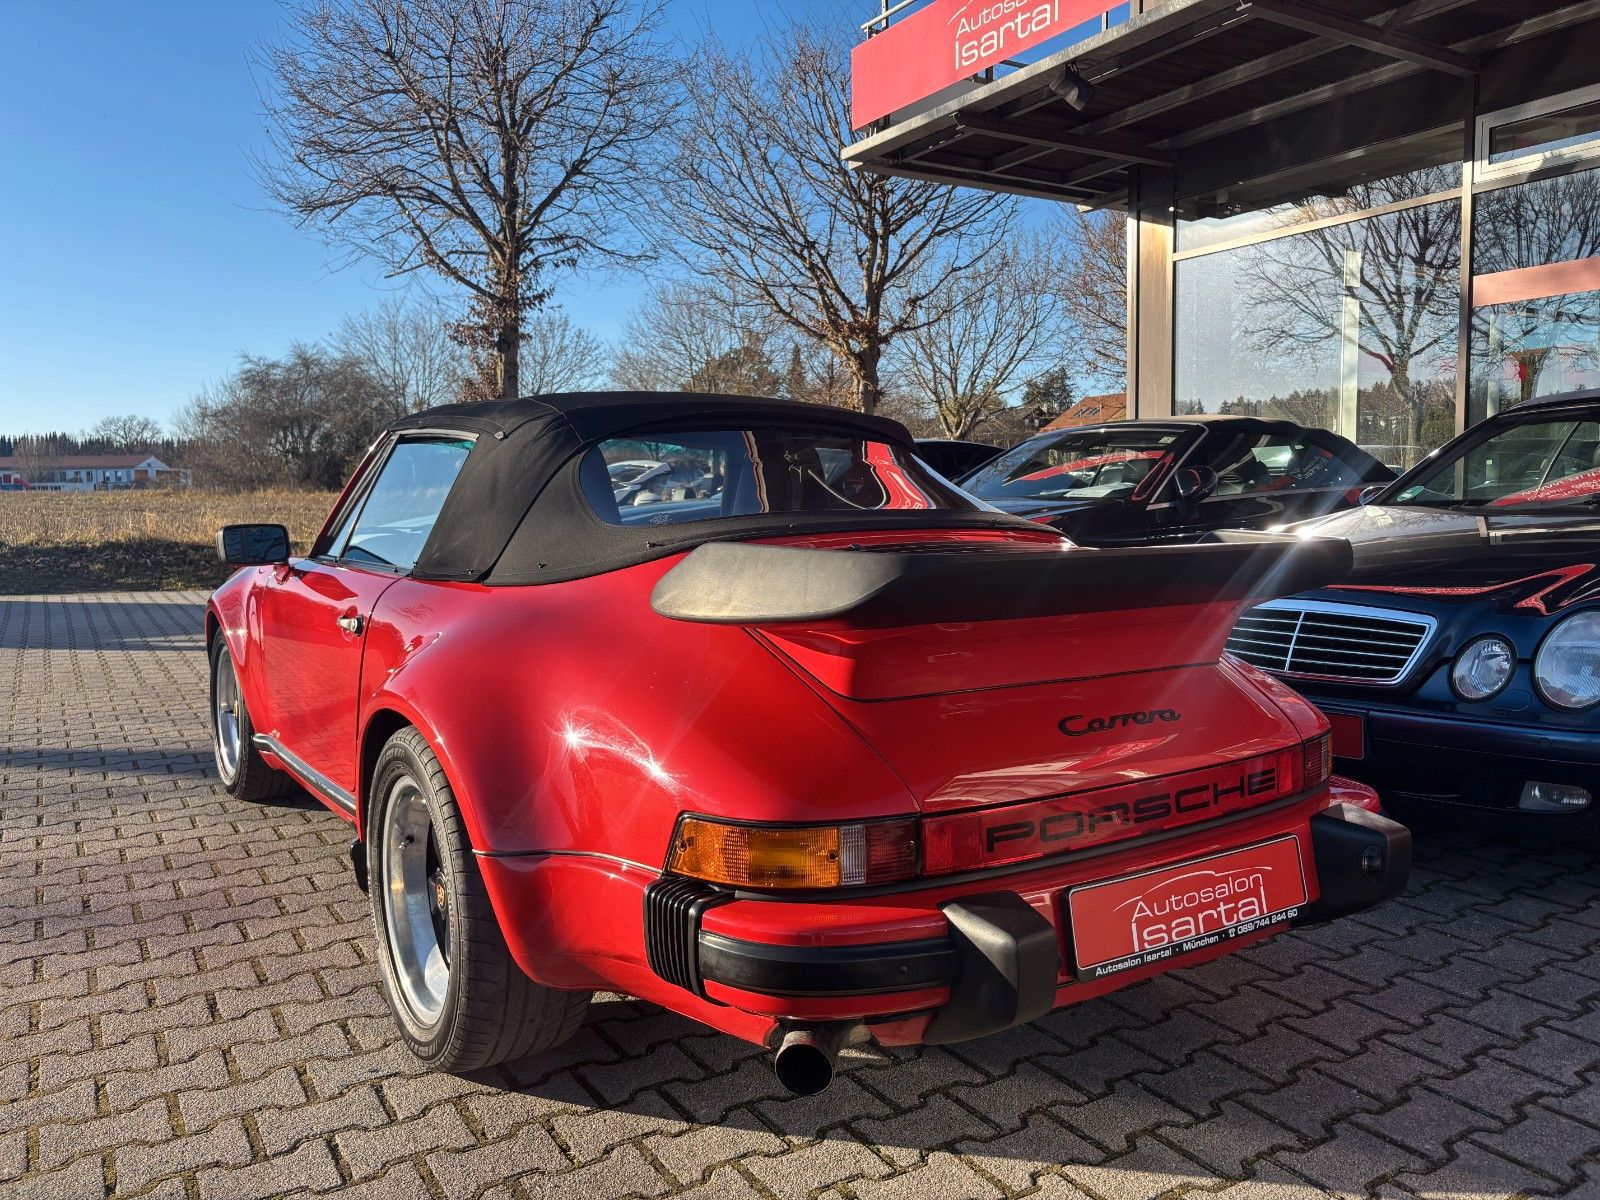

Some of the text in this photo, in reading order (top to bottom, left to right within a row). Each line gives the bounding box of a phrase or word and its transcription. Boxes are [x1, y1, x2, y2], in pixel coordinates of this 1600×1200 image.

[955, 0, 1059, 70] Isartal
[1058, 709, 1181, 736] Carrera
[986, 768, 1276, 852] PORSCHE
[1131, 873, 1263, 922] Autosalon
[1131, 885, 1268, 952] Isartal
[1095, 957, 1141, 976] Autosalon
[1144, 947, 1172, 962] Isartal
[1183, 934, 1219, 951] München
